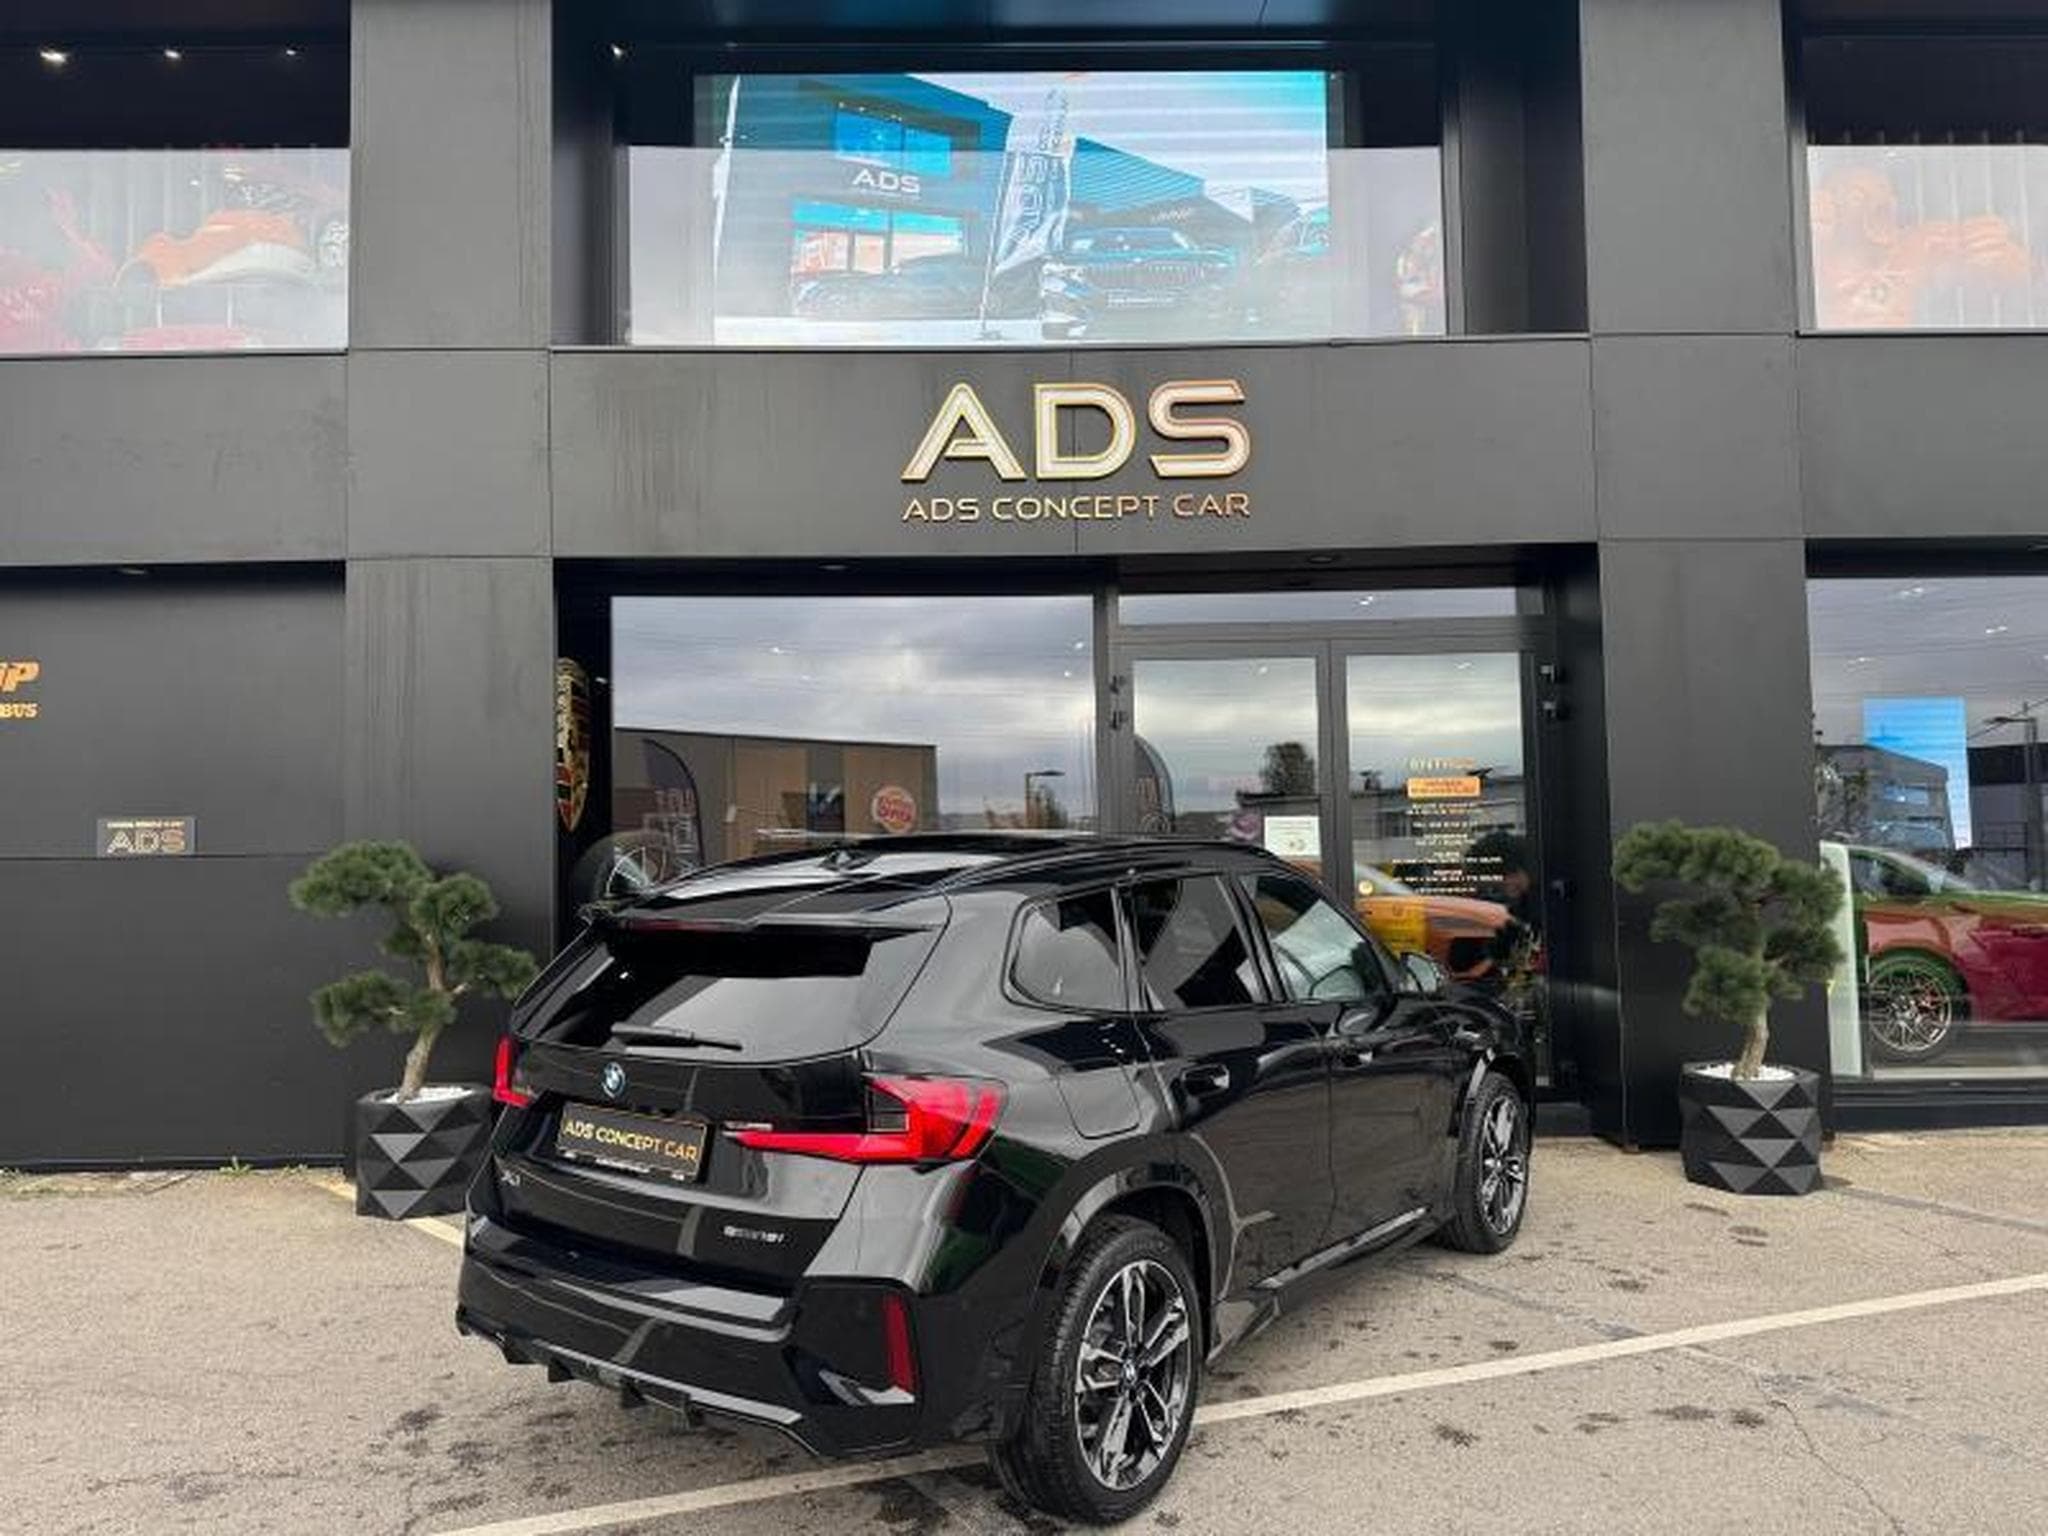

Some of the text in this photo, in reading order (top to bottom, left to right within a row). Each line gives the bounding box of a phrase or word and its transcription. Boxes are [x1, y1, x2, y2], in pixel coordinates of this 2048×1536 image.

[852, 168, 921, 193] ADS
[900, 379, 1252, 481] ADS
[902, 492, 1251, 522] ADS CONCEPT CAR
[107, 831, 185, 854] ADS
[563, 1120, 698, 1161] ADS CONCEPT CAR
